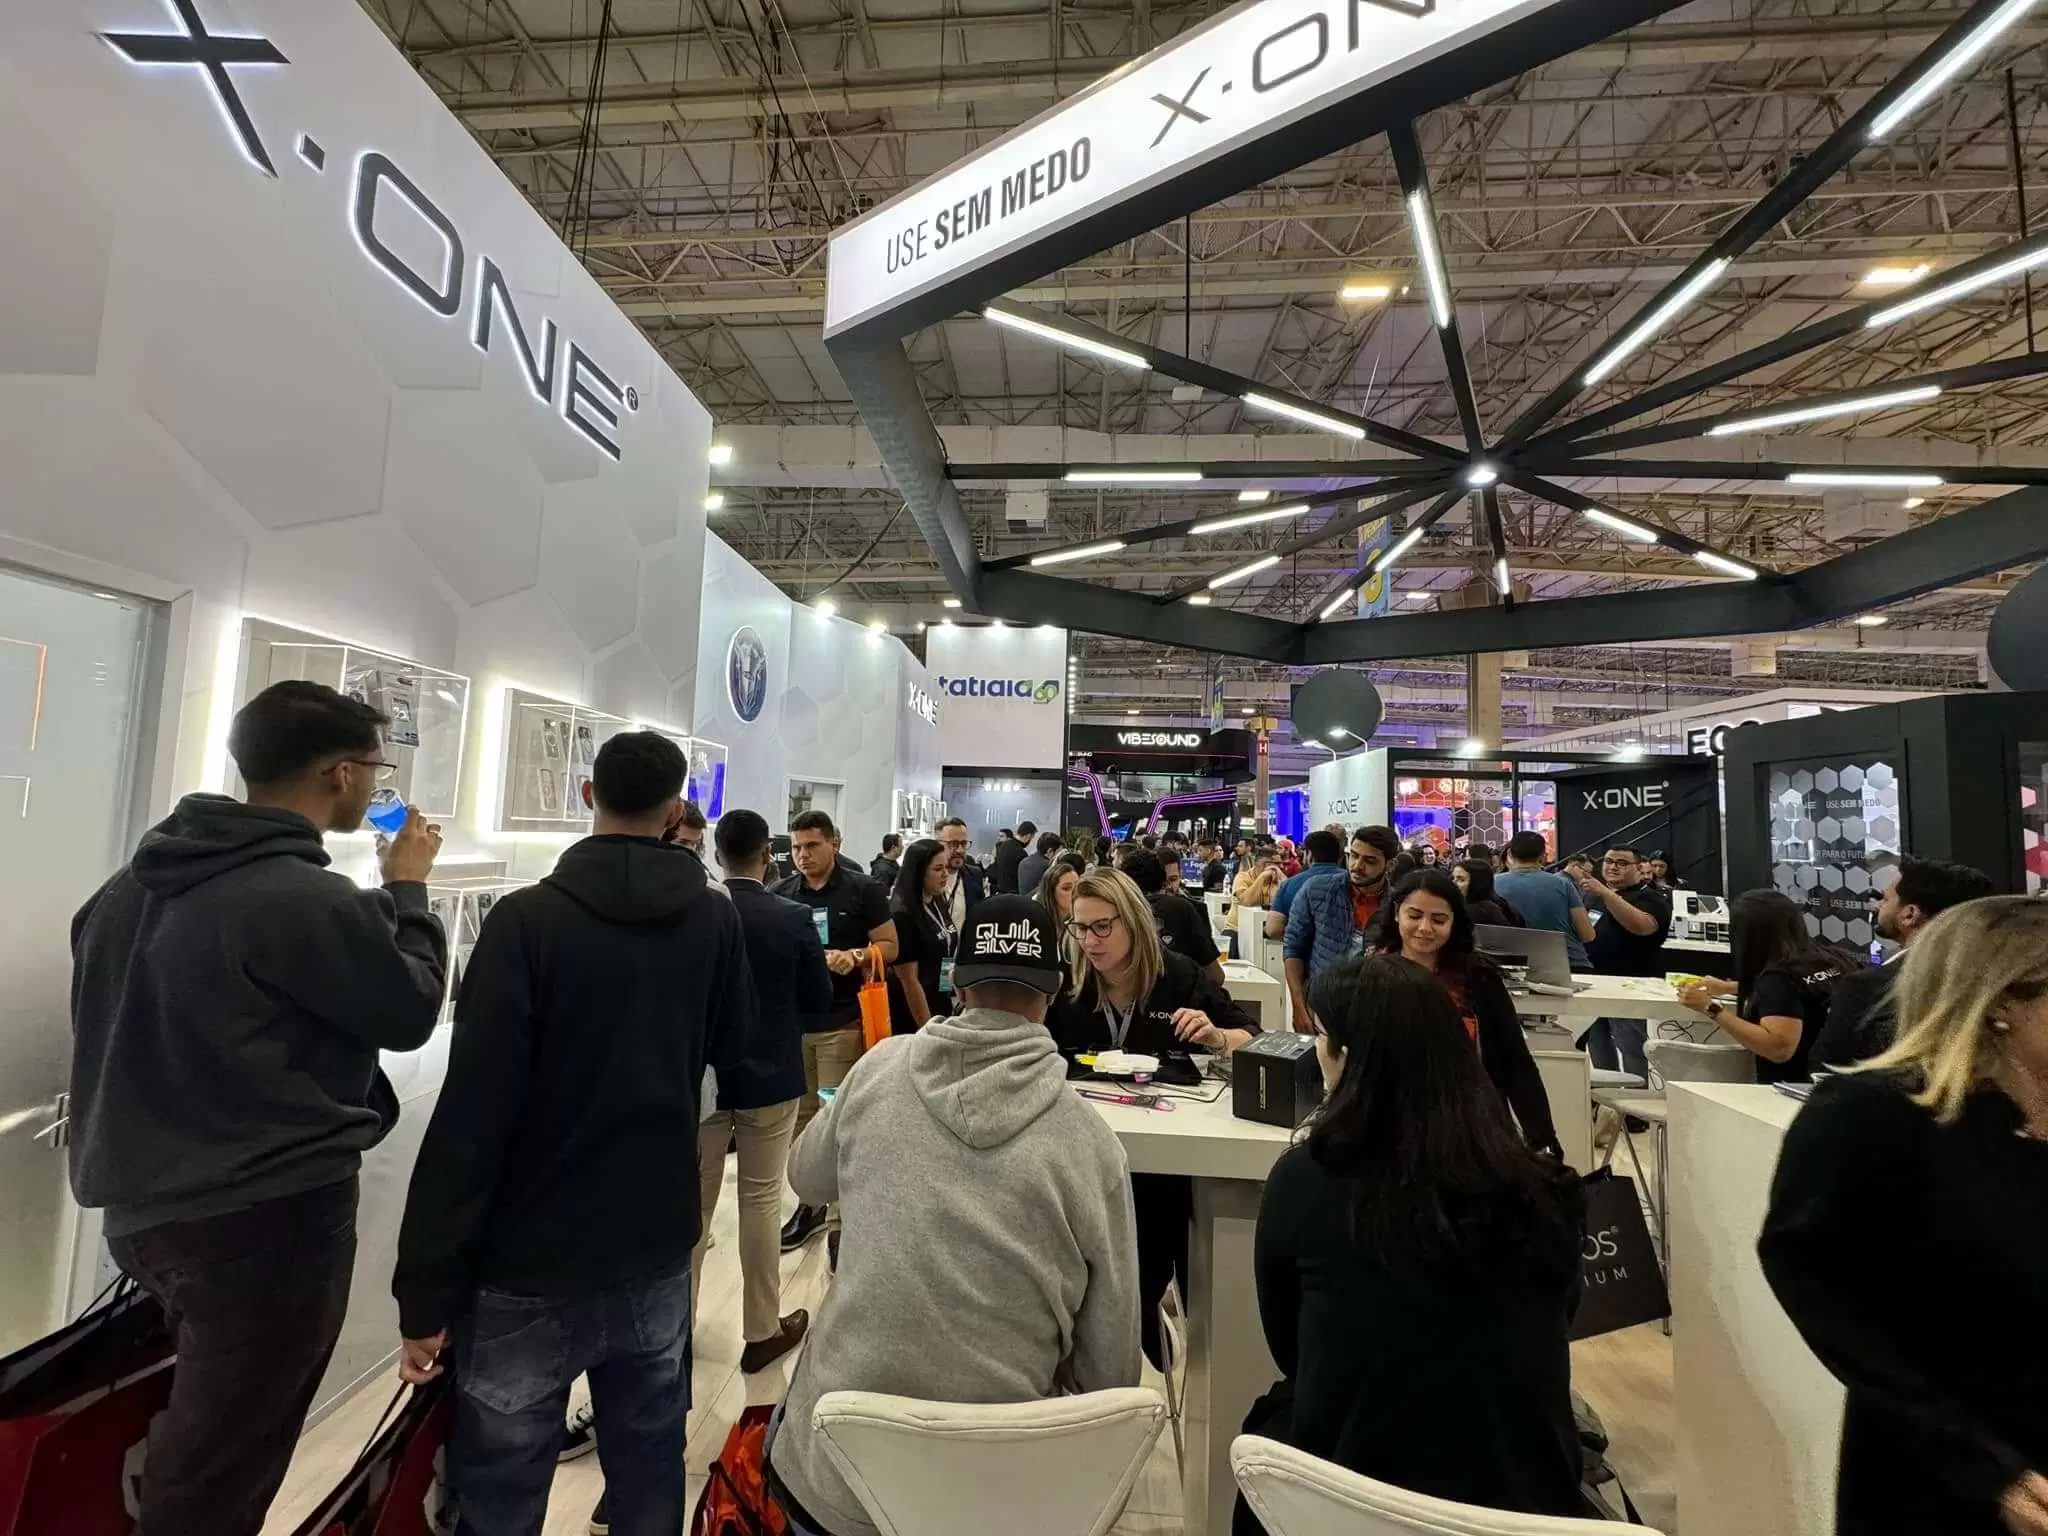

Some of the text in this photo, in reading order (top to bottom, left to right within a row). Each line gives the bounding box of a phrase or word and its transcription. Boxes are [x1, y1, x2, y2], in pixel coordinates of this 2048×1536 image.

[887, 219, 928, 273] USE
[934, 186, 992, 250] SEM
[1001, 136, 1091, 219] MEDO
[1117, 732, 1200, 747] VIBESOUND
